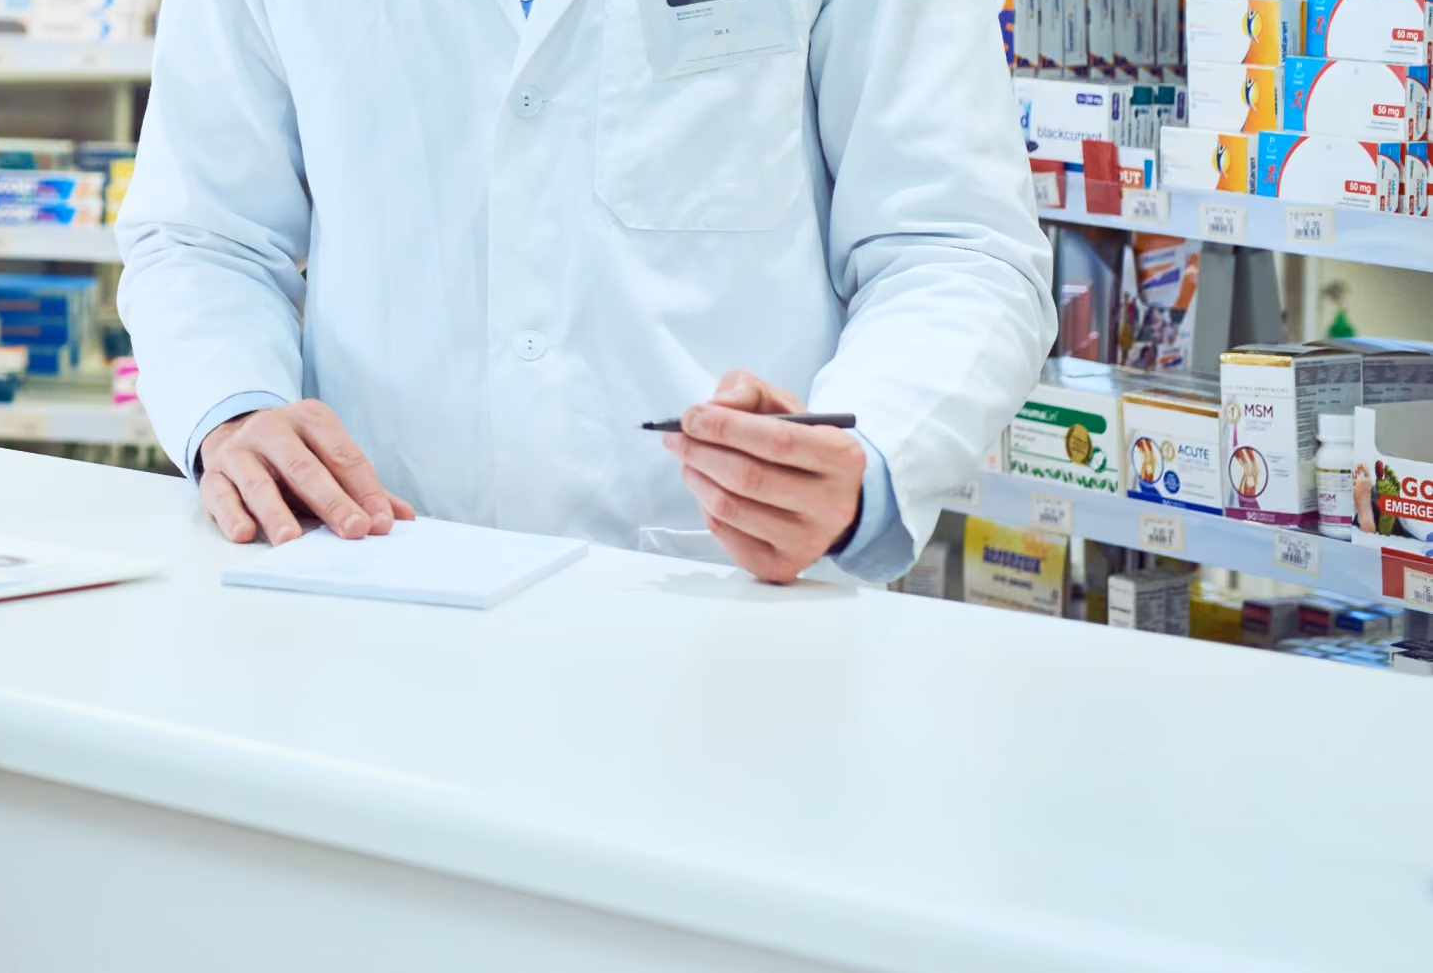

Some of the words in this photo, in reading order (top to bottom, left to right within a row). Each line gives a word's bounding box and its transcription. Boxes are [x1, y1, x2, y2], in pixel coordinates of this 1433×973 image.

[1407, 32, 1419, 41] mg
[1387, 107, 1400, 118] mg
[1359, 184, 1372, 194] mg
[1244, 403, 1274, 419] MSM
[1177, 444, 1210, 460] ACUTE
